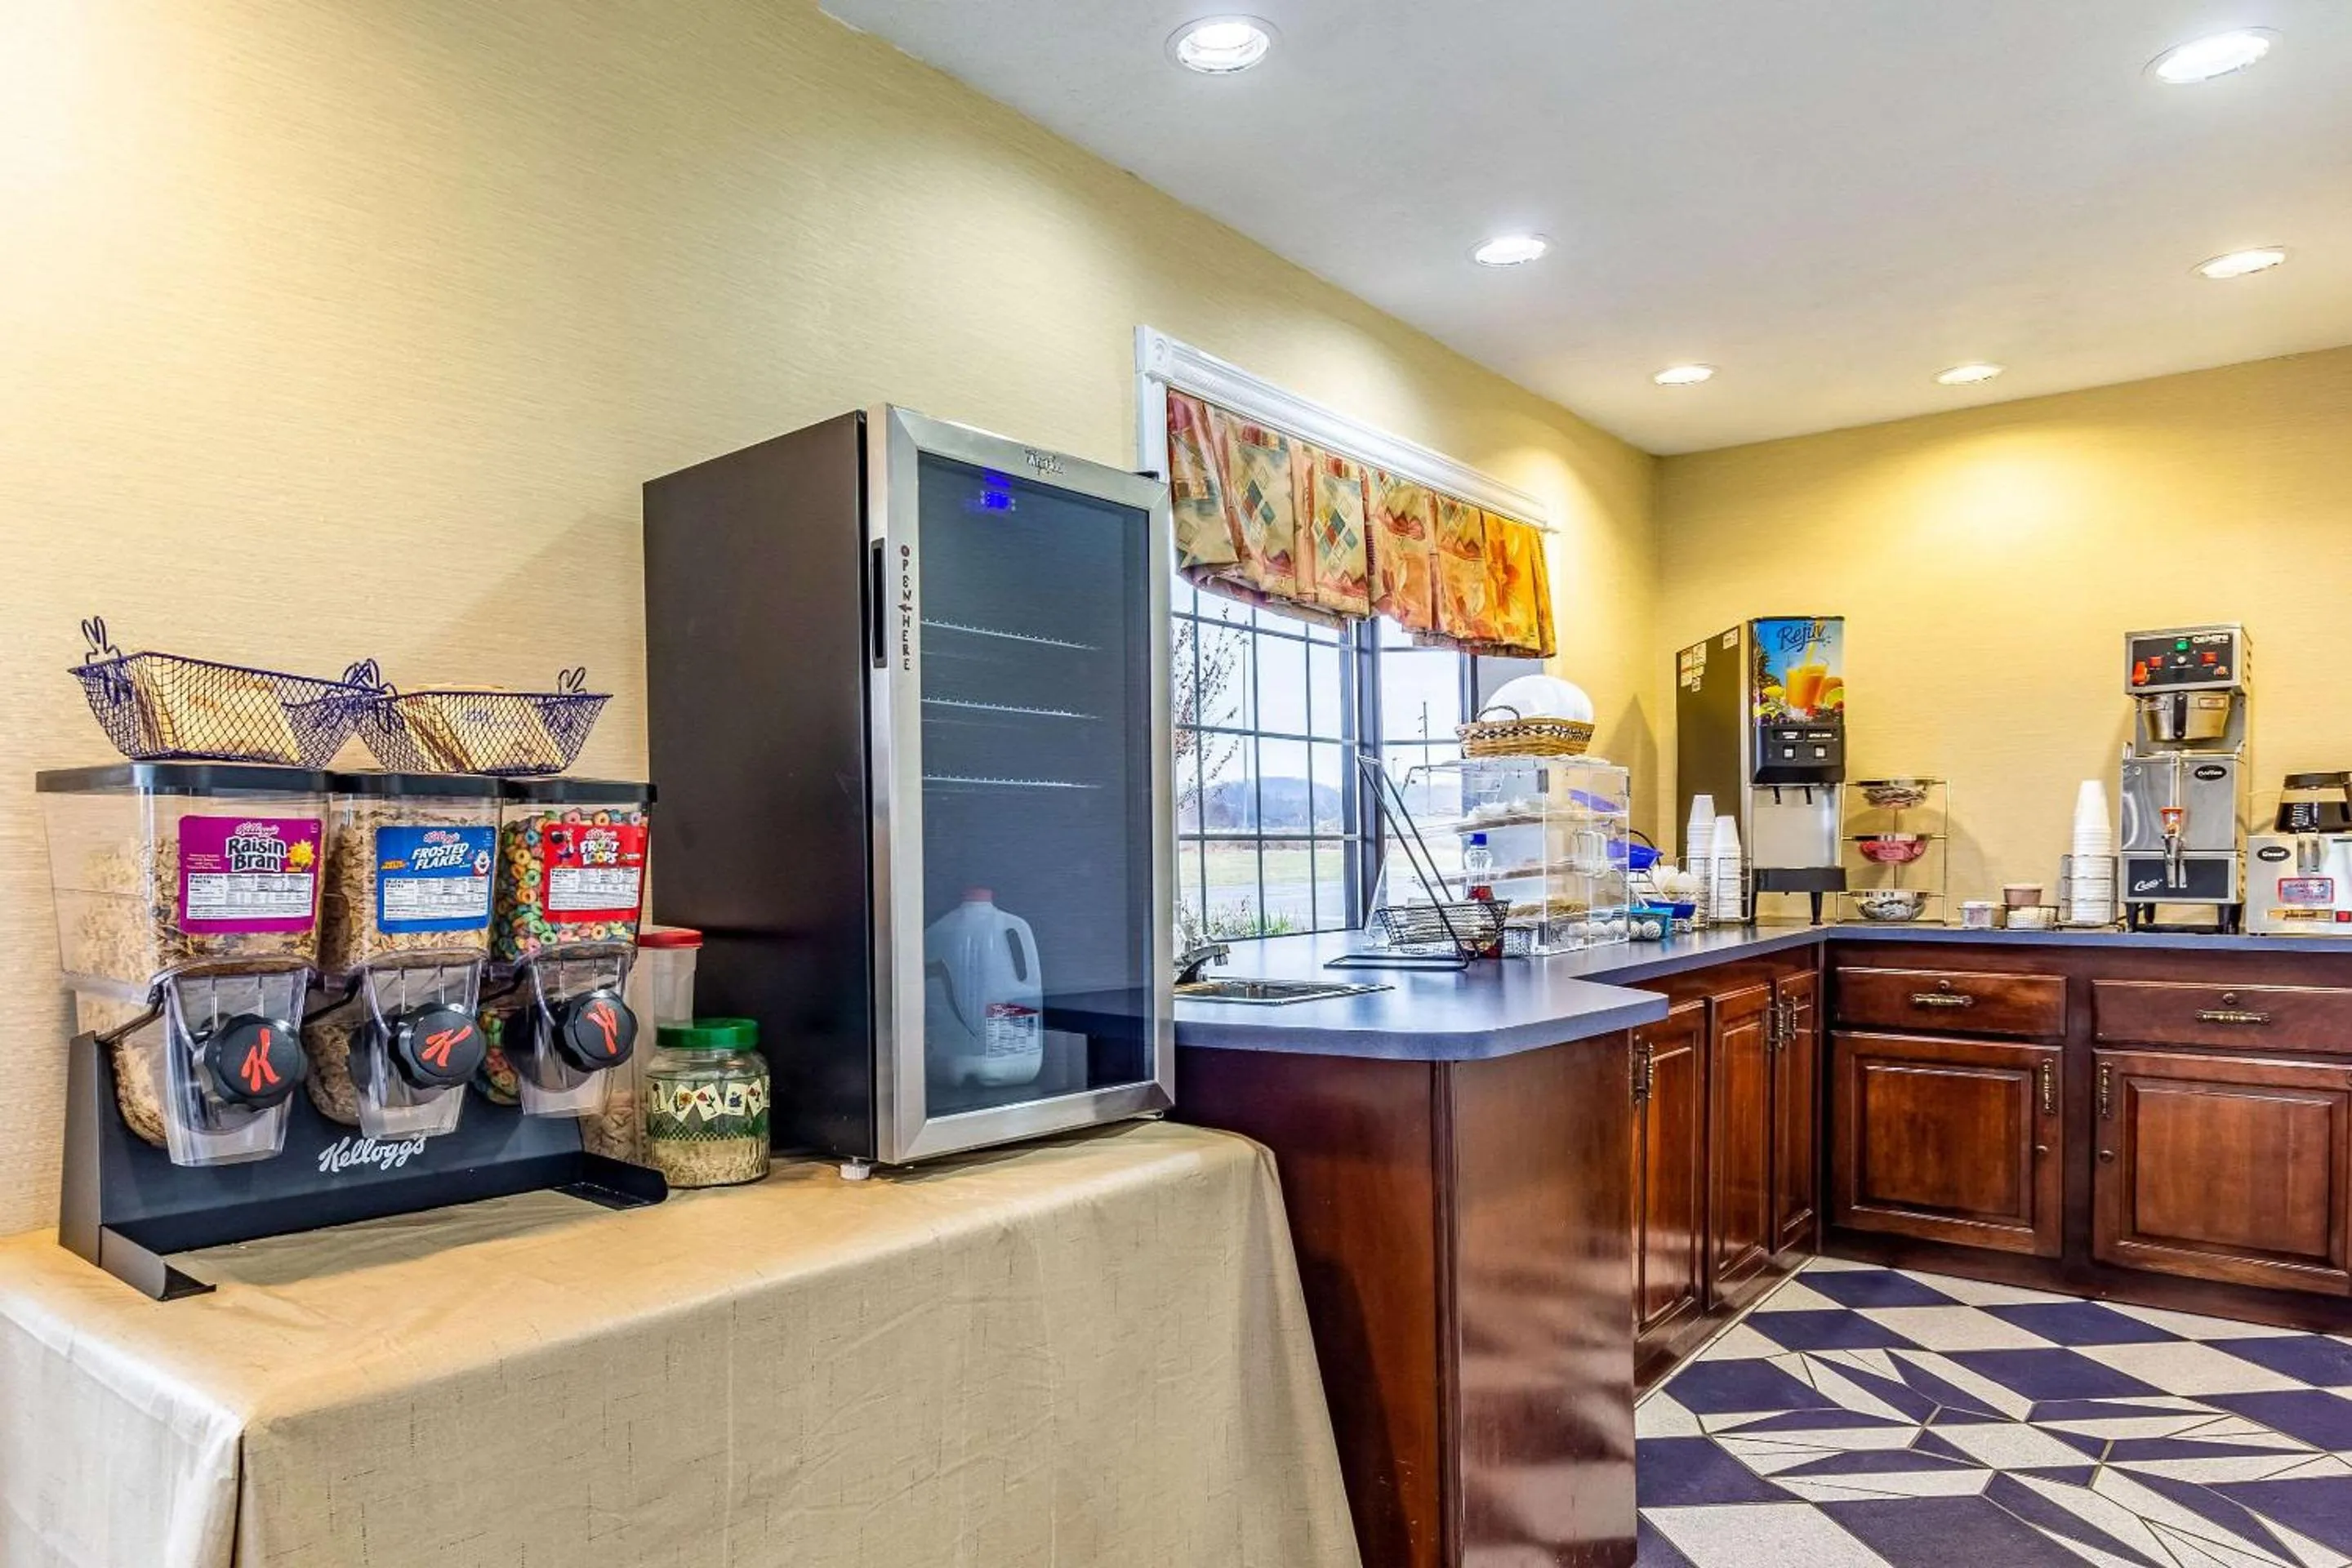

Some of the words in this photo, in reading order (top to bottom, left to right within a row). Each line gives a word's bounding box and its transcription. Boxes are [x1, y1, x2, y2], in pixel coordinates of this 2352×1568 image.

[901, 545, 911, 601] OPEN
[902, 615, 911, 670] HERE
[227, 838, 285, 857] Raisin
[412, 843, 470, 859] FROSTED
[234, 854, 279, 871] Bran
[415, 855, 464, 871] FLAKES
[241, 1027, 282, 1093] K
[318, 1134, 425, 1172] Kellogg's
